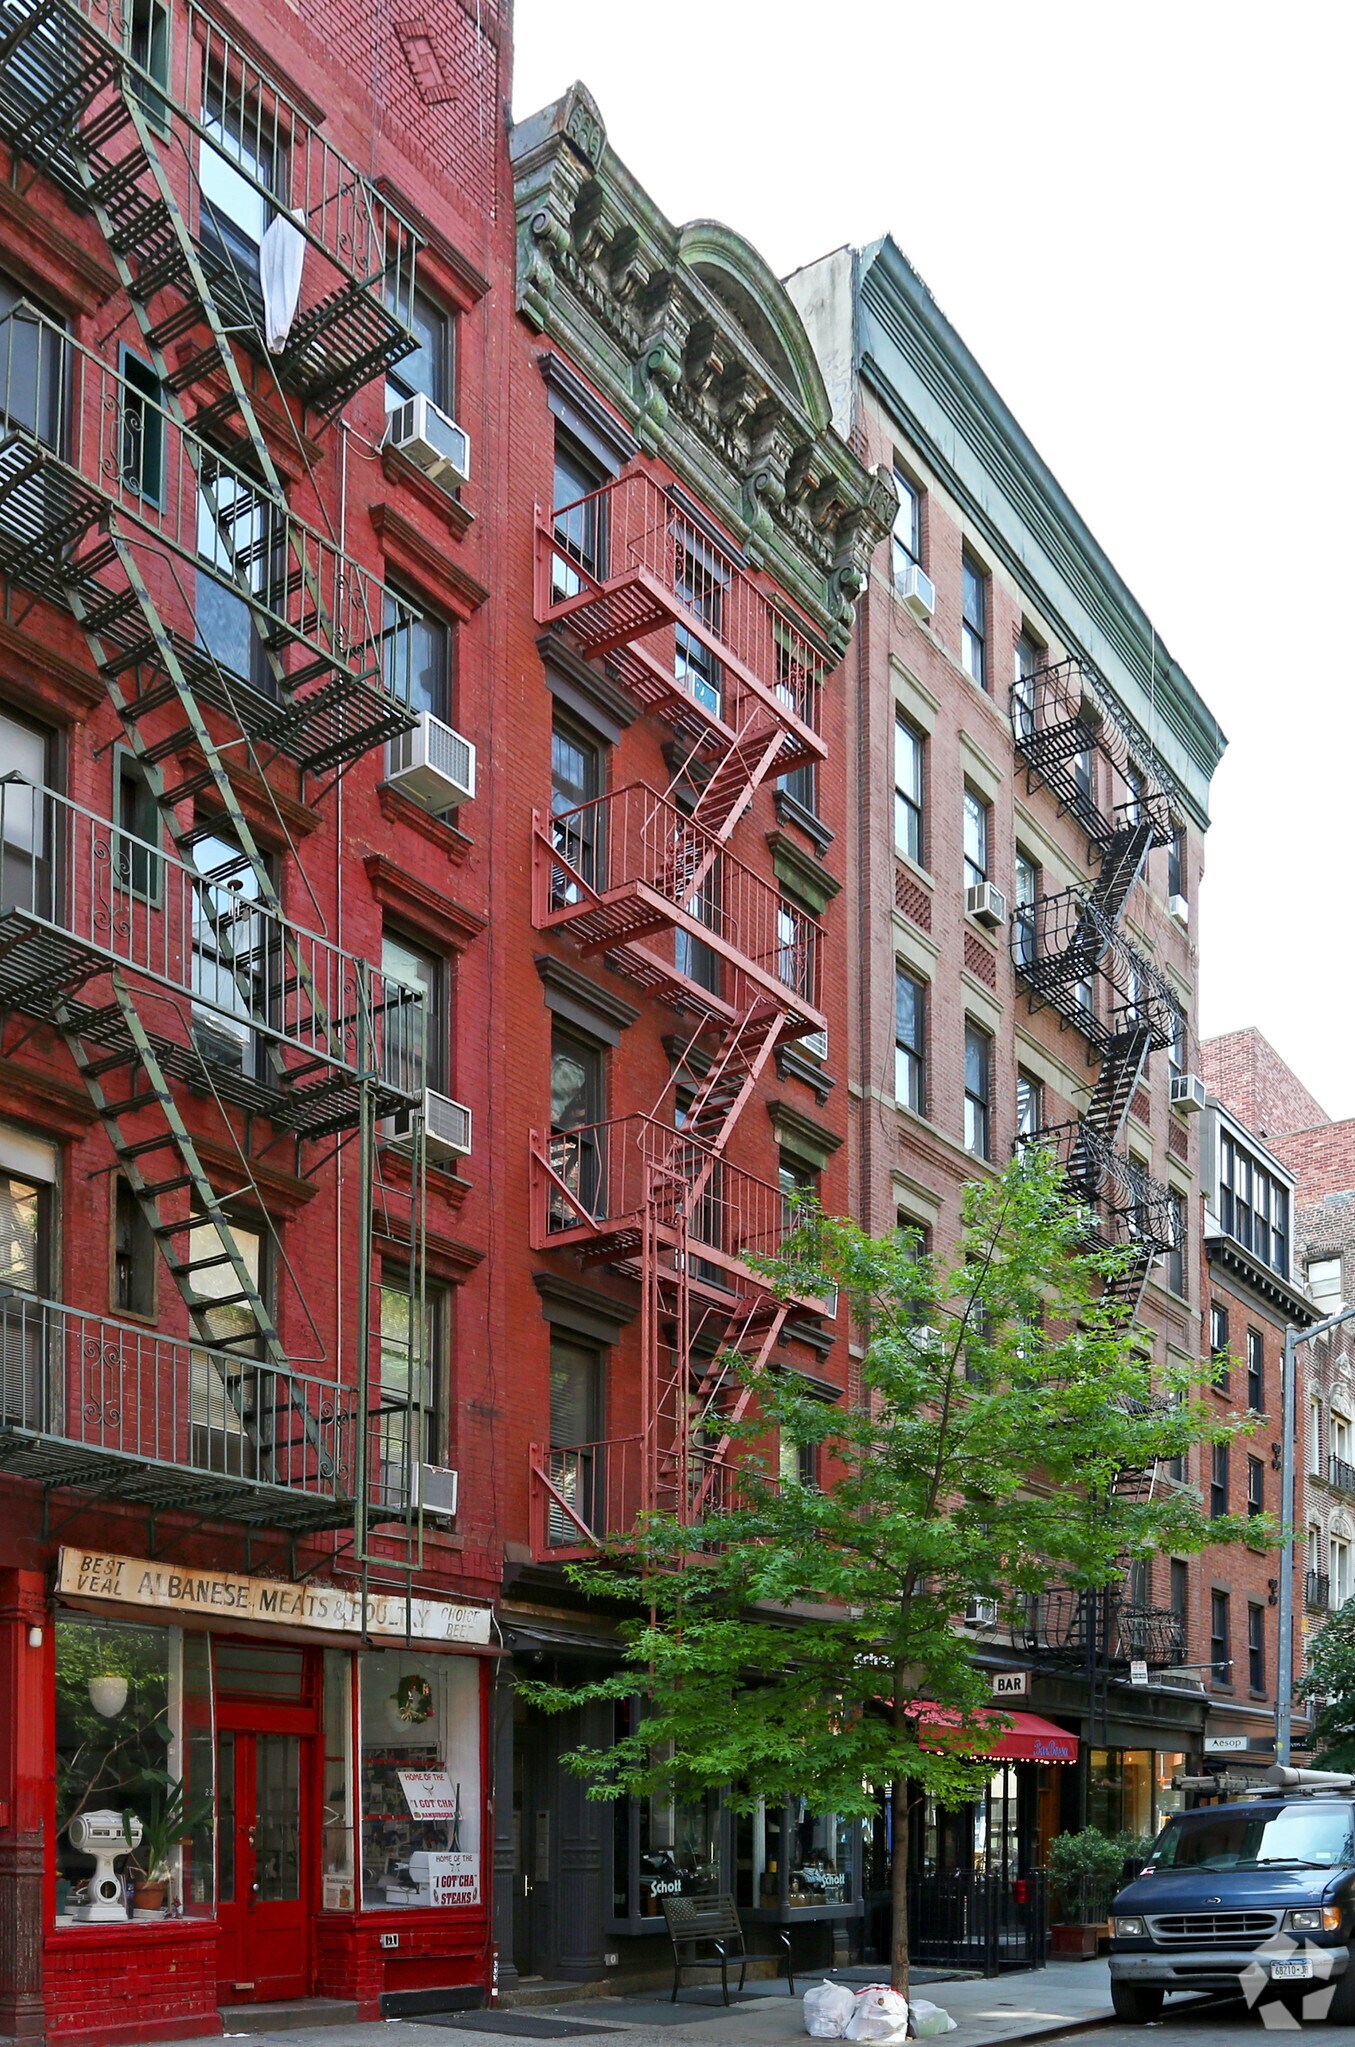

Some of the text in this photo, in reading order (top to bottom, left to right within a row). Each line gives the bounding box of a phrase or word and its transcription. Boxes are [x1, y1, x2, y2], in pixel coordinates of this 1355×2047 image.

[80, 1556, 125, 1577] BEST
[77, 1574, 122, 1596] VEAL
[138, 1571, 430, 1628] ALBANESE MEATS & POUTY
[998, 1677, 1021, 1691] BAR
[436, 1854, 452, 1862] HOME
[462, 1854, 473, 1862] THE
[650, 1879, 682, 1898] Schott
[821, 1872, 845, 1888] Schott
[441, 1891, 472, 1905] STEAKS
